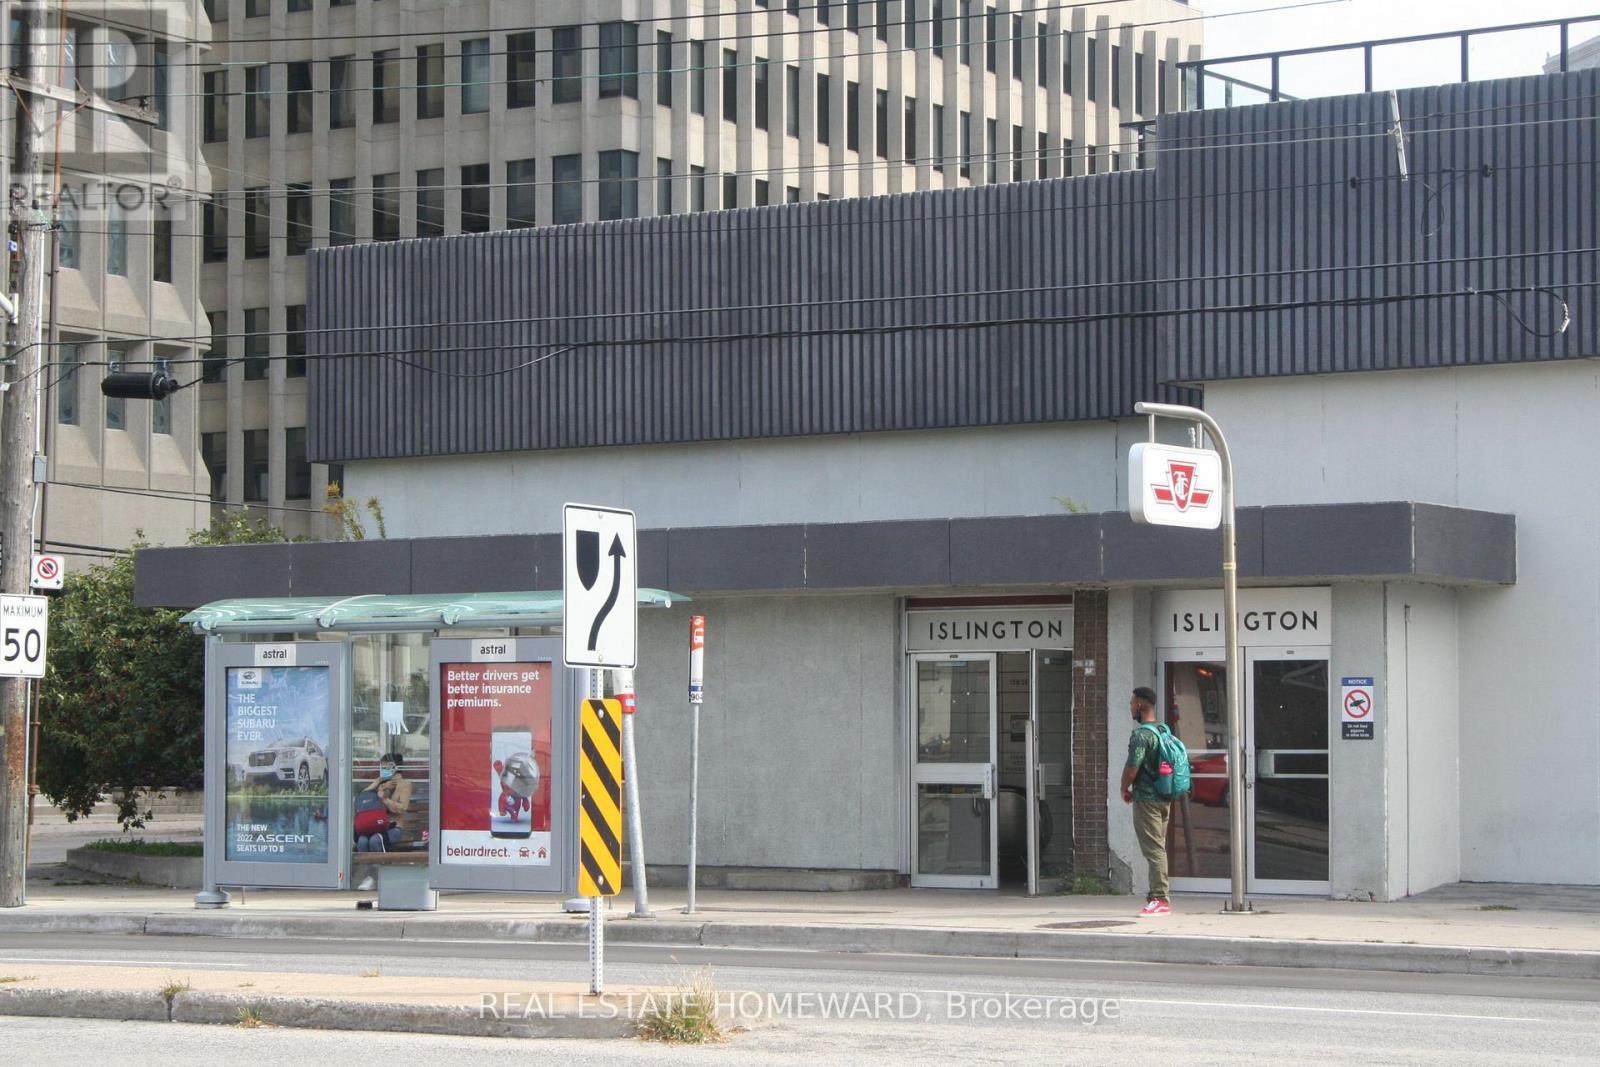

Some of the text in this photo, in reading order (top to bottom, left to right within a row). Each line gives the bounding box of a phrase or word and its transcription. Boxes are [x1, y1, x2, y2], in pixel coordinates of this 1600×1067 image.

[3, 605, 43, 618] MAXIMUM
[1173, 610, 1318, 632] ISLIGTON
[929, 620, 1063, 640] ISLINGTON
[4, 628, 41, 662] 50
[480, 645, 506, 655] astral
[262, 649, 287, 659] astral
[447, 670, 540, 682] Better drivers get
[447, 683, 532, 694] better insurance
[238, 693, 256, 703] THE
[447, 697, 502, 709] premiums.
[238, 706, 278, 716] BIGGEST
[238, 718, 276, 728] SUBARU
[237, 823, 249, 831] THE
[237, 834, 314, 843] 2022 ASCENT
